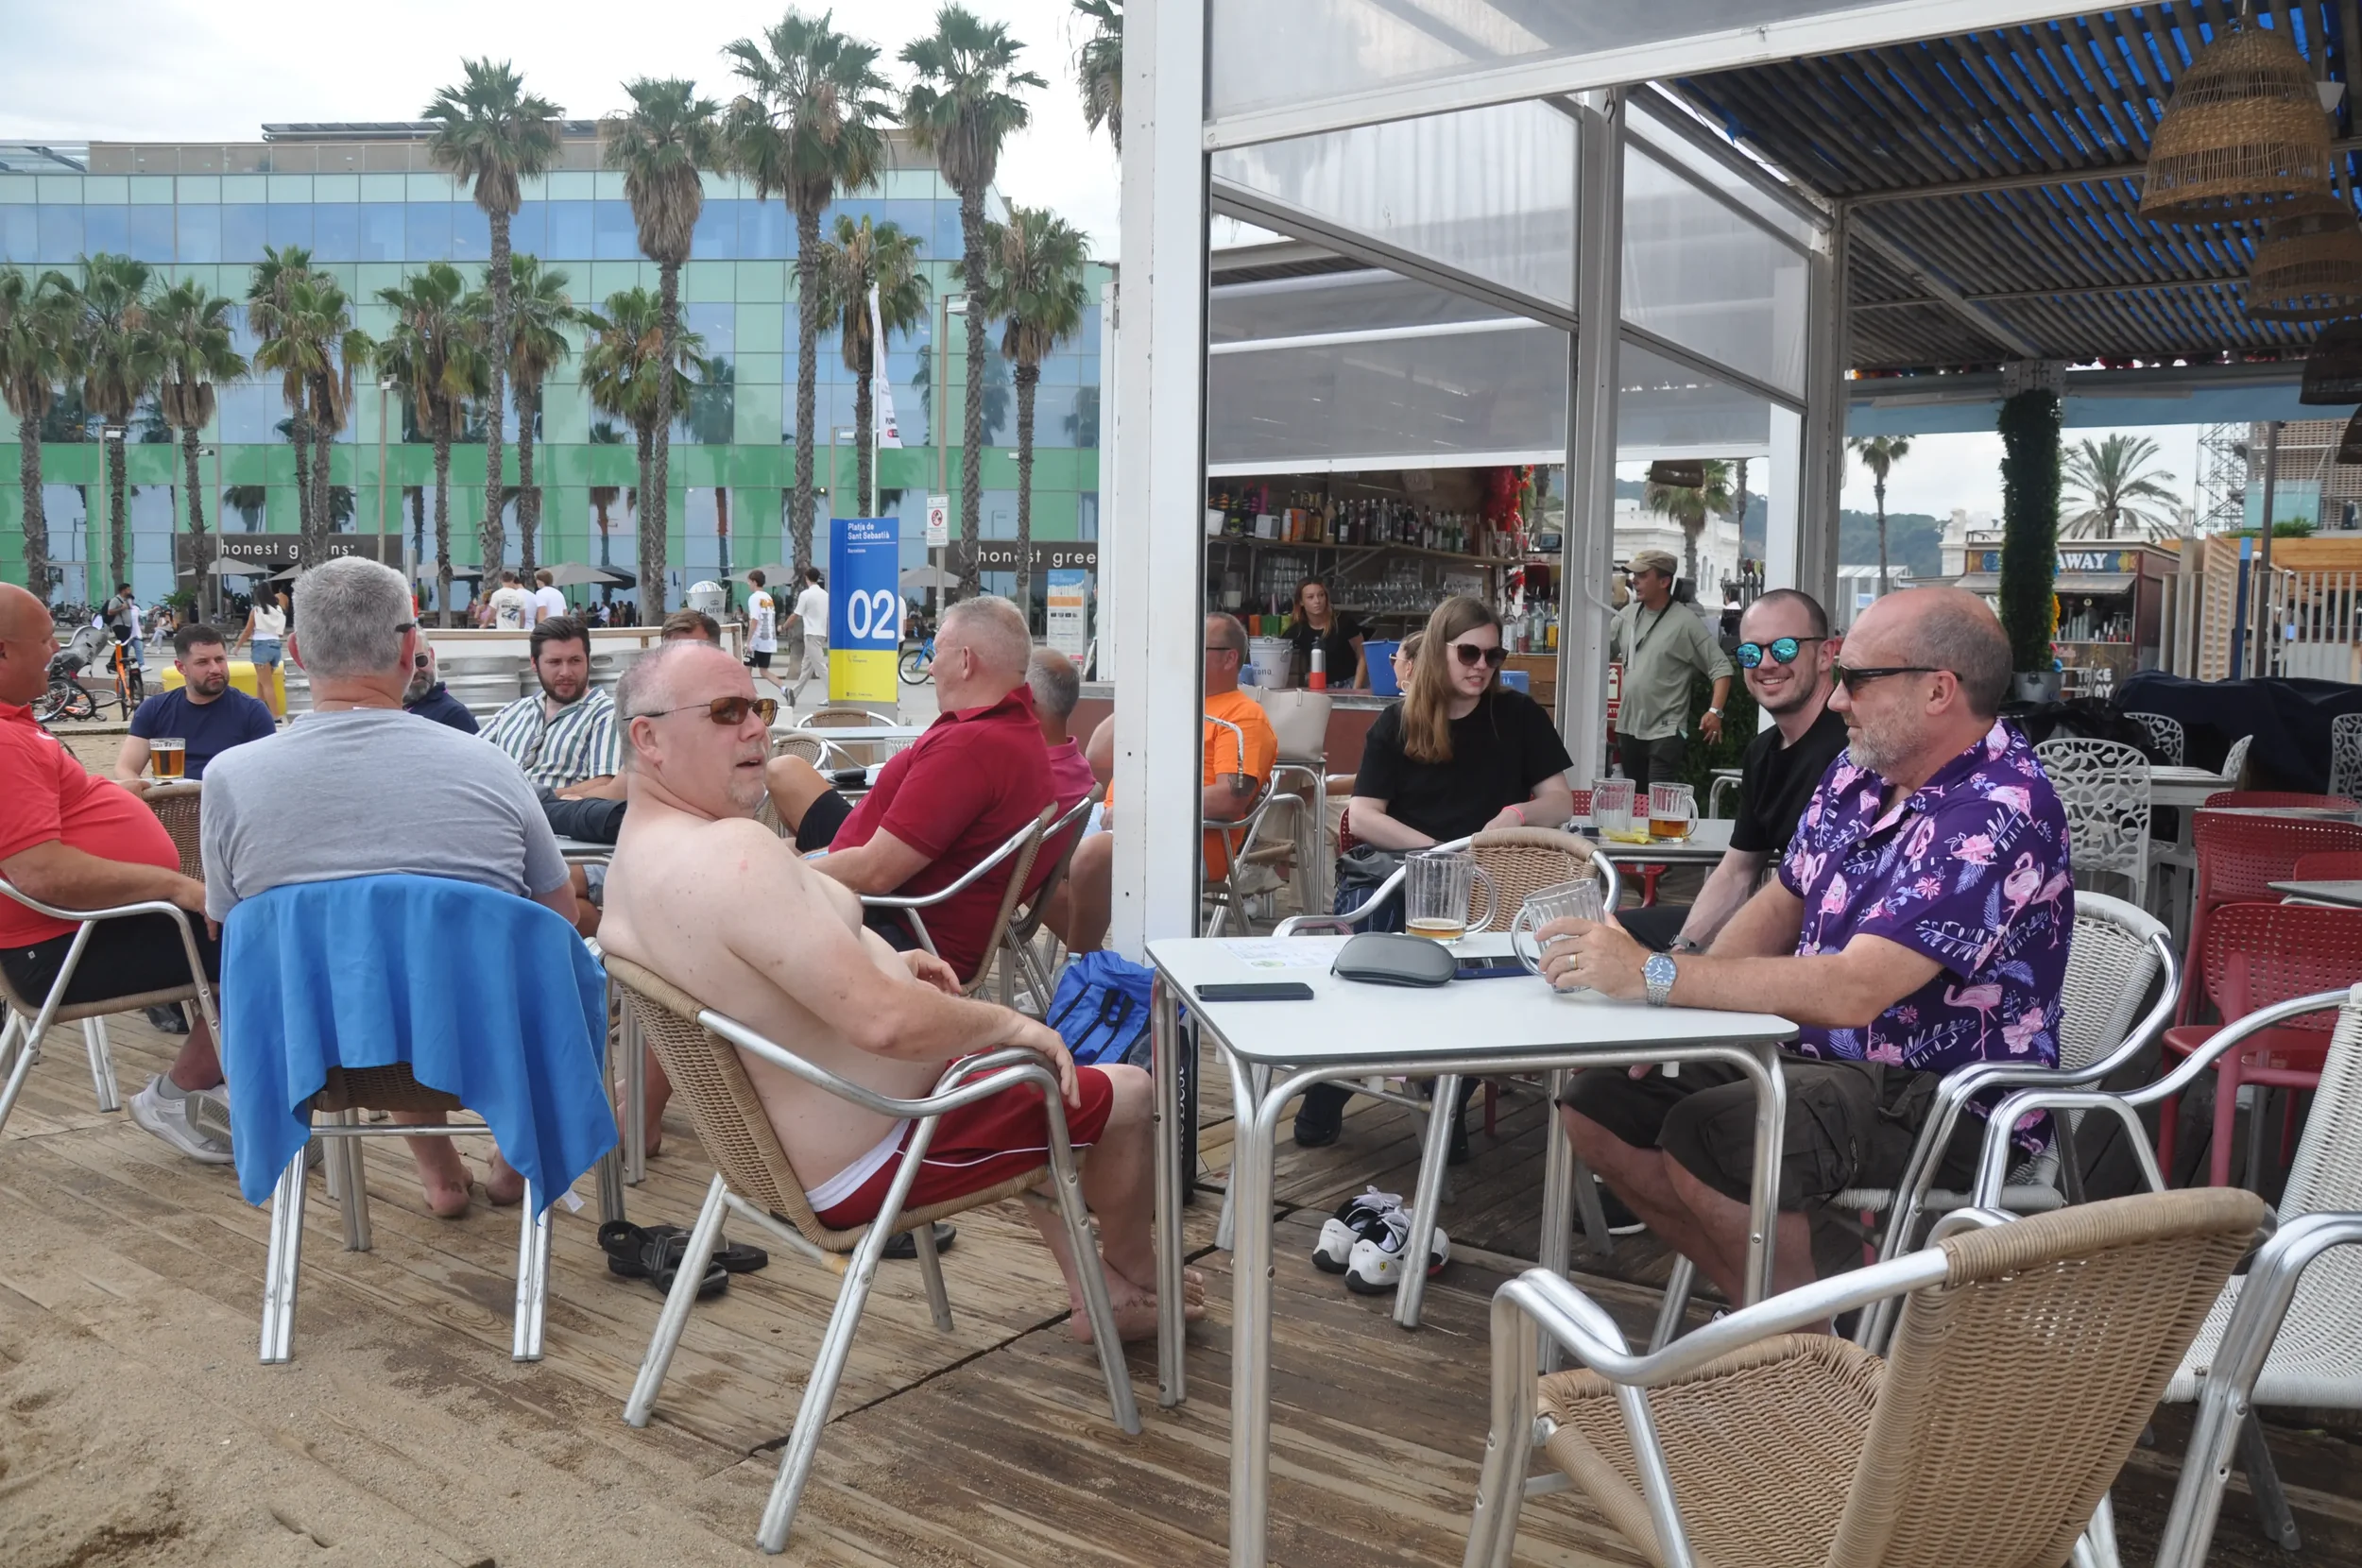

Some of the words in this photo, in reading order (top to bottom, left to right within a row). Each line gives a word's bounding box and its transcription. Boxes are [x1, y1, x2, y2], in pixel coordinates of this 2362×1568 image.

[847, 522, 865, 532] Platja
[866, 522, 875, 531] de
[847, 532, 863, 540] Sant
[863, 530, 890, 539] Sebastià
[221, 538, 279, 555] honest
[289, 544, 349, 559] gns
[1053, 553, 1097, 569] gree
[847, 588, 896, 639] 02
